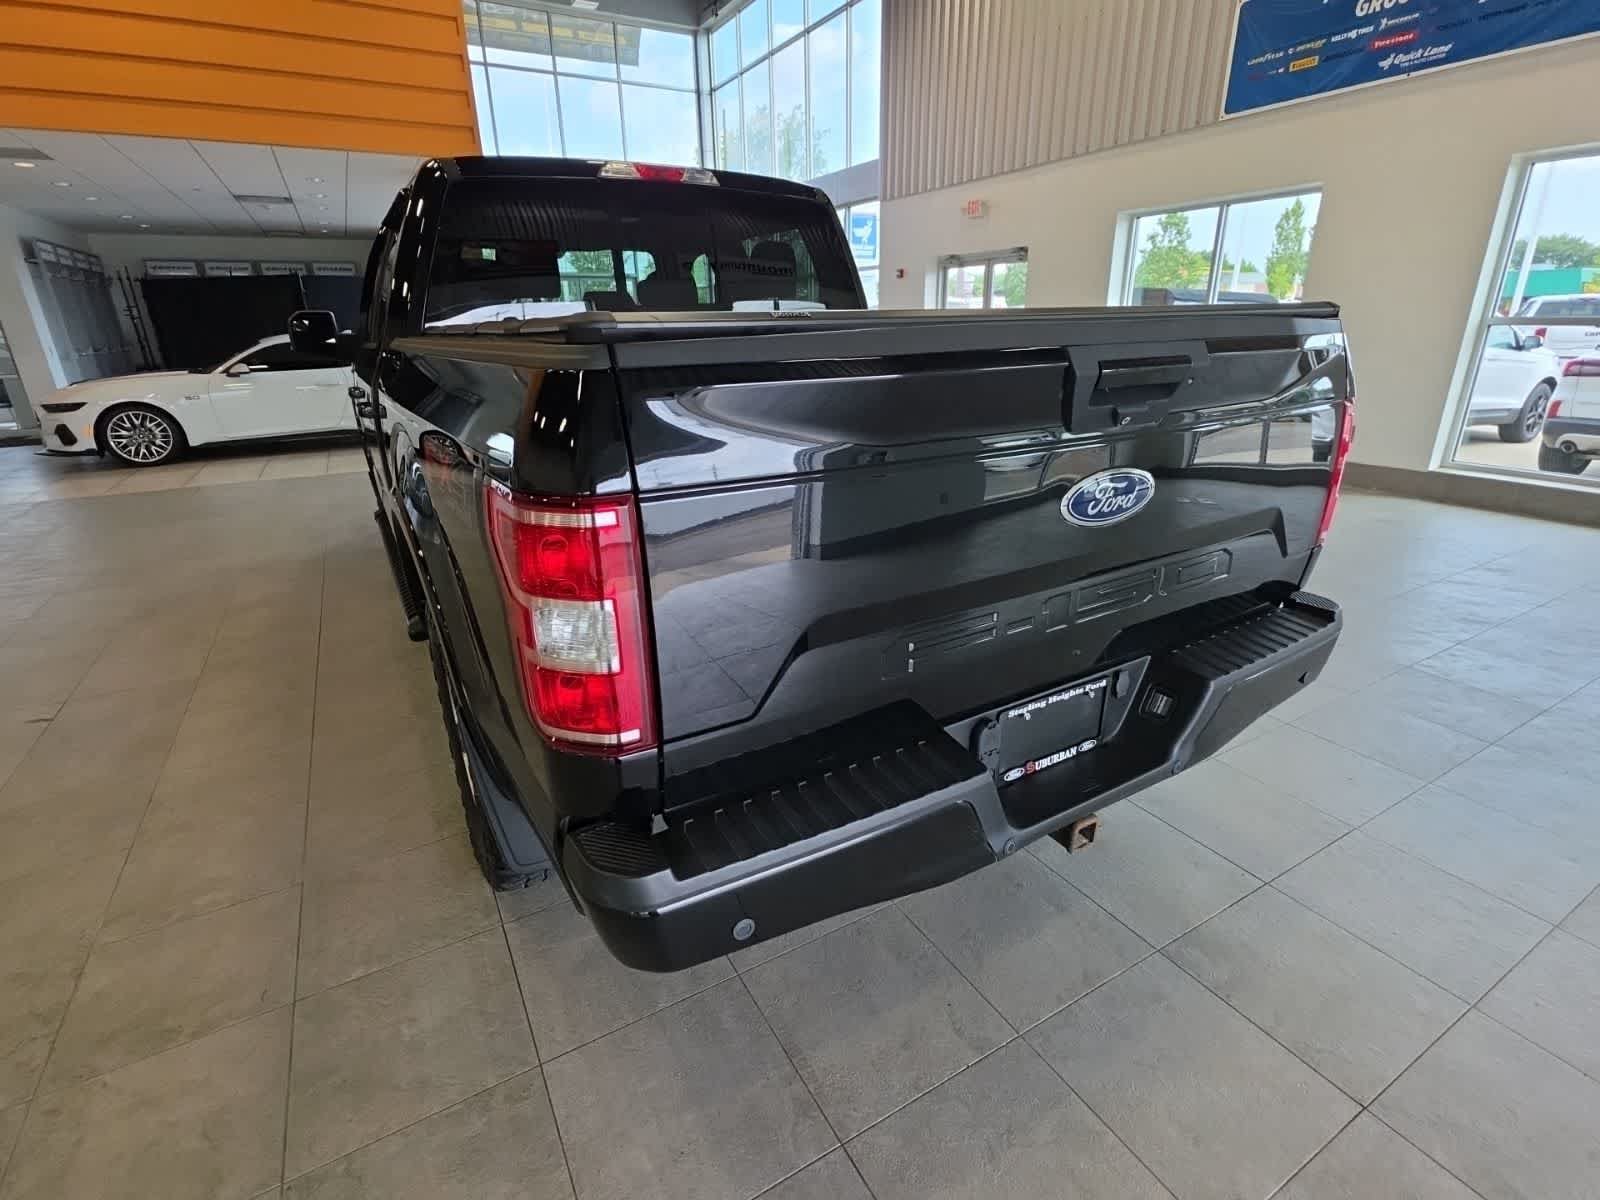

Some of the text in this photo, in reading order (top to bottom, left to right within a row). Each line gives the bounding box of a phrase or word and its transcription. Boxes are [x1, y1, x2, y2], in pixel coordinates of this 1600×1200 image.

[1087, 480, 1138, 517] Ford
[1008, 679, 1107, 718] Sterling Heights Ford
[1025, 746, 1078, 774] SUBURBAN
